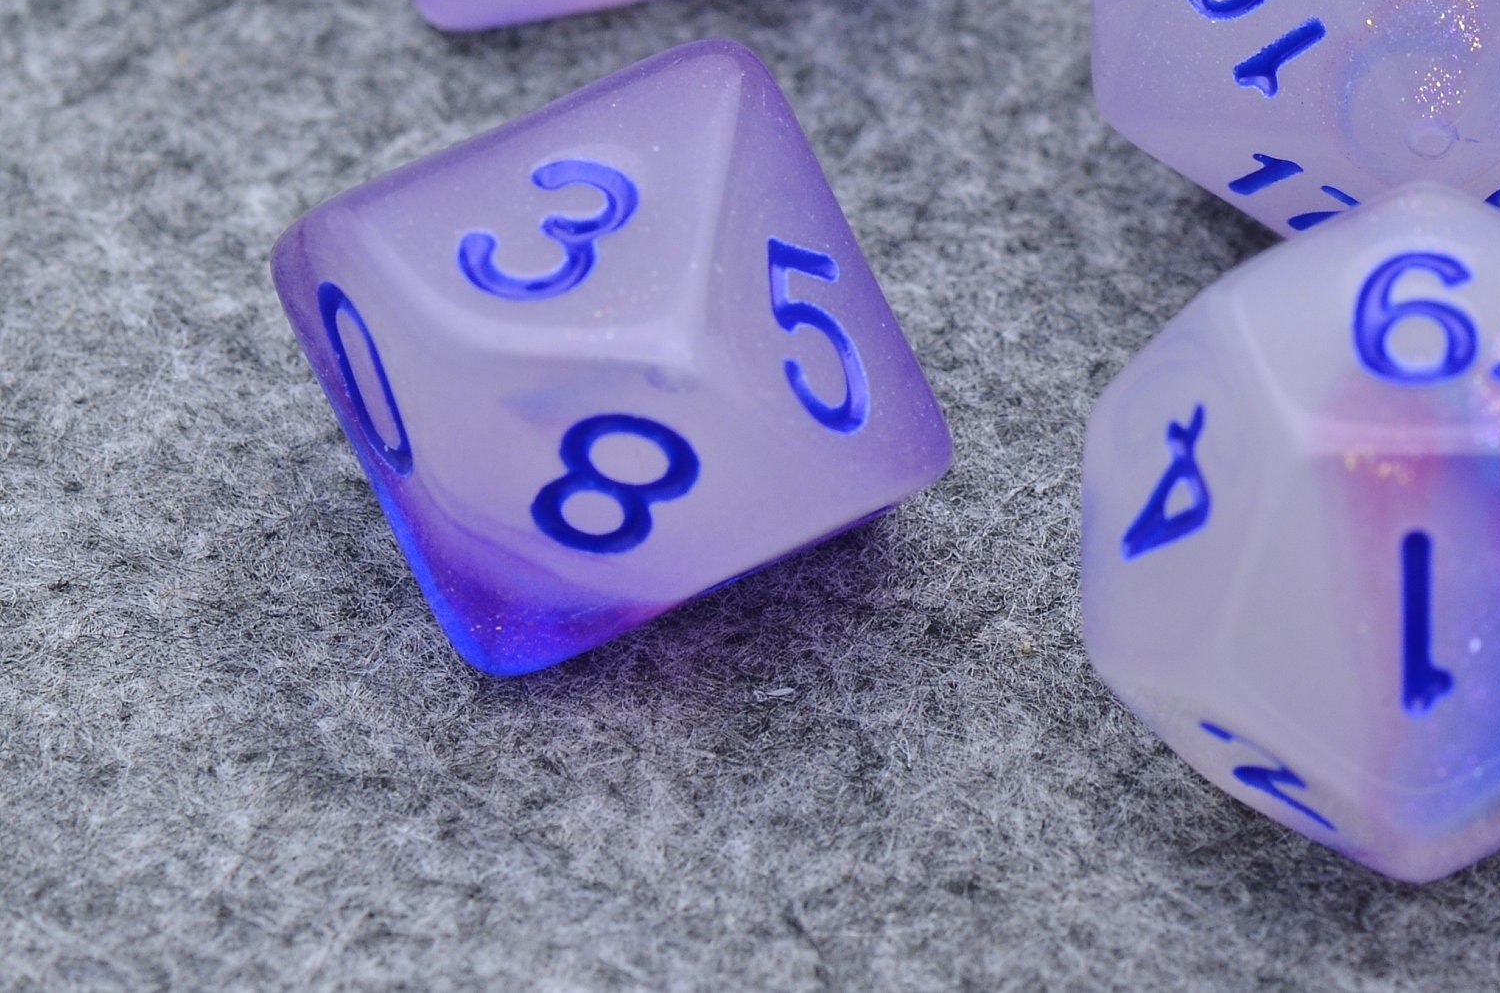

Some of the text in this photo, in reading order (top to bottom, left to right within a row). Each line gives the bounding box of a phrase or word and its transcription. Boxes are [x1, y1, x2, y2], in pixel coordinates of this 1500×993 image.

[456, 157, 639, 300] 3
[317, 280, 413, 479] 0
[767, 235, 870, 435] 5
[530, 413, 699, 555] 8
[1120, 403, 1211, 560] 4
[1402, 528, 1455, 717] 1
[1200, 721, 1337, 831] 2
